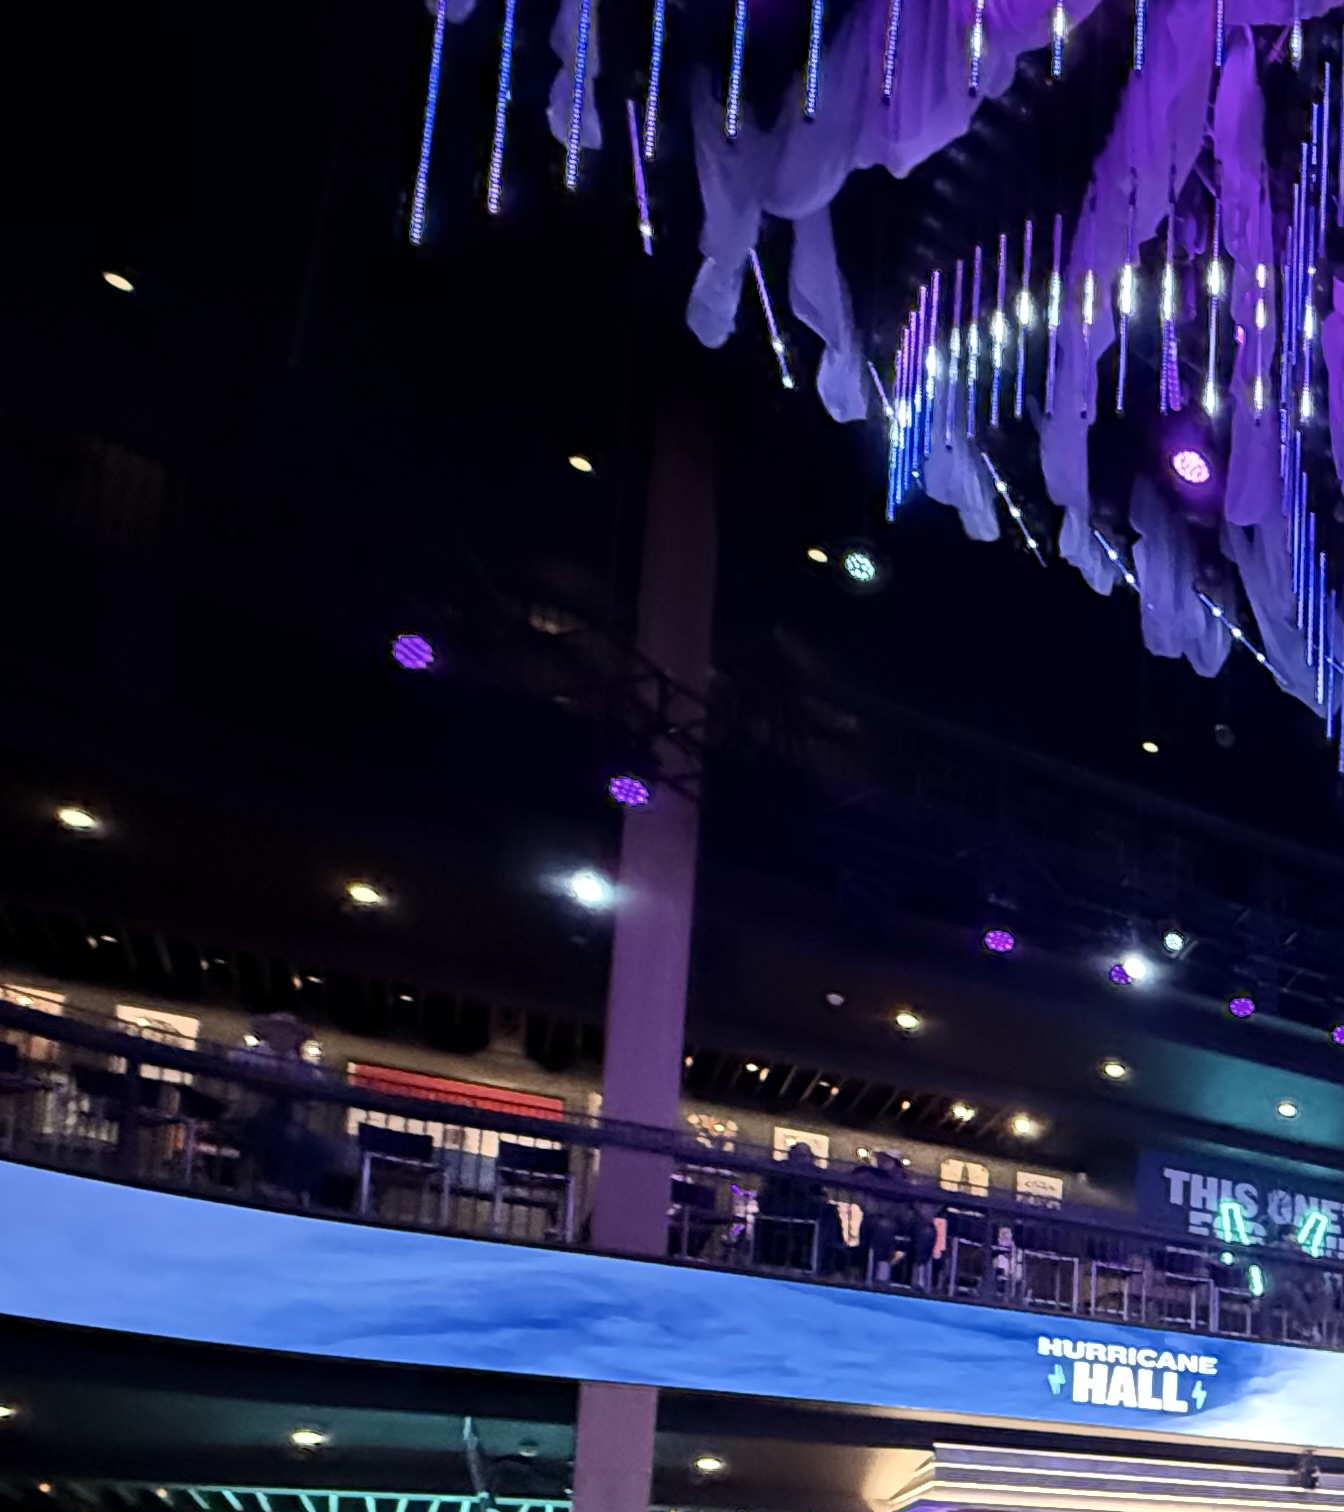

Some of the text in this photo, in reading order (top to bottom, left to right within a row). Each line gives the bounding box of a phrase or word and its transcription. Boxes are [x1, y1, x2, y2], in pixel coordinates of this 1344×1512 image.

[1163, 1167, 1259, 1218] THIS
[1037, 1336, 1218, 1375] HURRICANE
[1072, 1361, 1188, 1413] HALL
